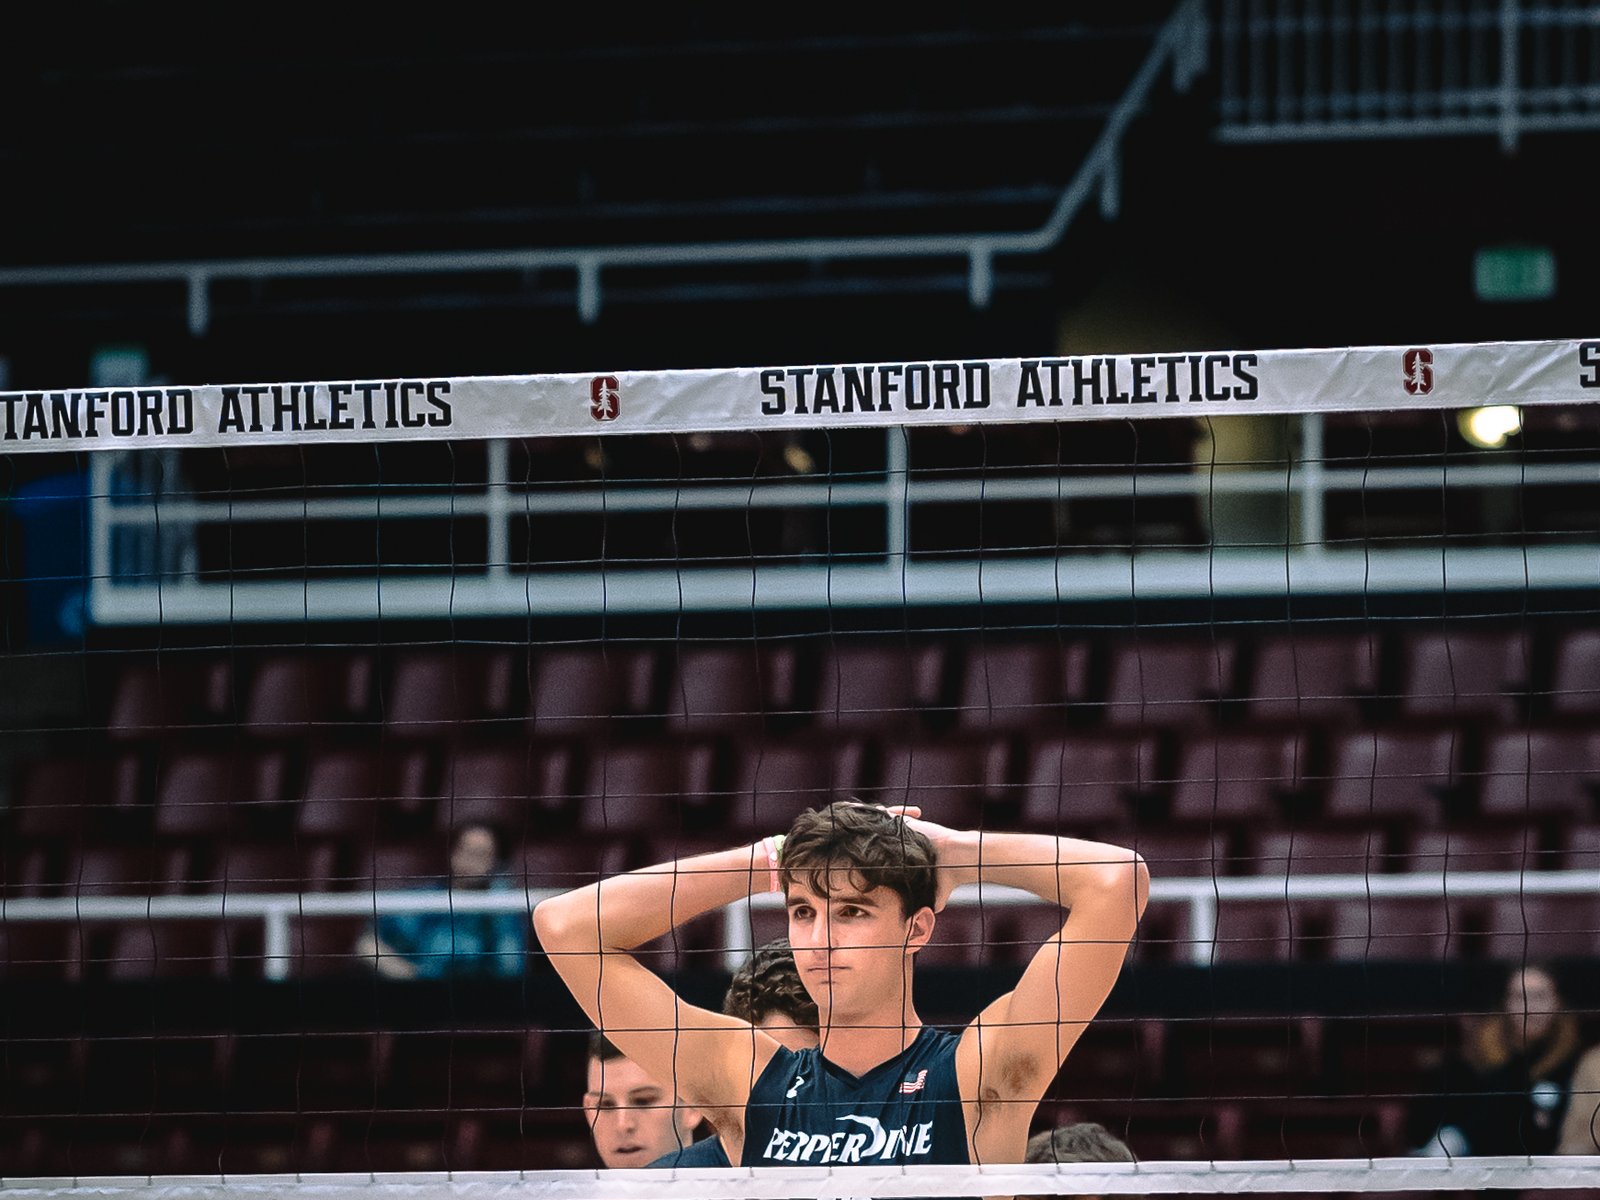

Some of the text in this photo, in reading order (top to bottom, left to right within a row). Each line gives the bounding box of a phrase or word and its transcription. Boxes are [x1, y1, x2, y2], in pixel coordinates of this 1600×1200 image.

[219, 382, 452, 434] ATHLETICS
[761, 353, 1258, 414] STANFORD ATHLETICS
[763, 1114, 933, 1164] PEPPERDINE
